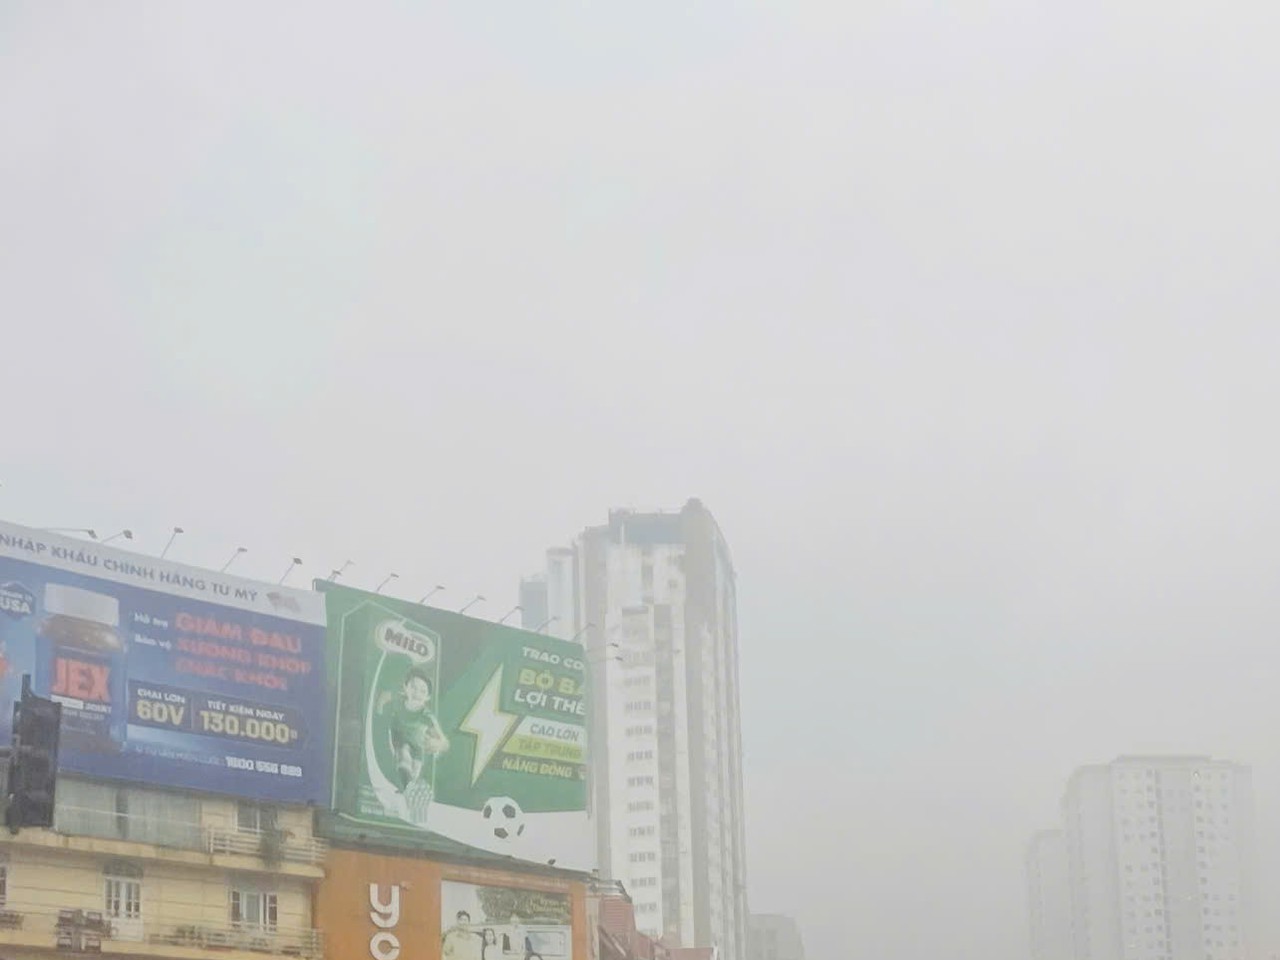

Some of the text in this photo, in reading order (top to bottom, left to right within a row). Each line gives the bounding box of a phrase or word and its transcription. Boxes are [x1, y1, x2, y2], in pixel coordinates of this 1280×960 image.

[384, 627, 428, 657] MILO
[522, 646, 560, 665] TRAO
[137, 701, 185, 725] 60V
